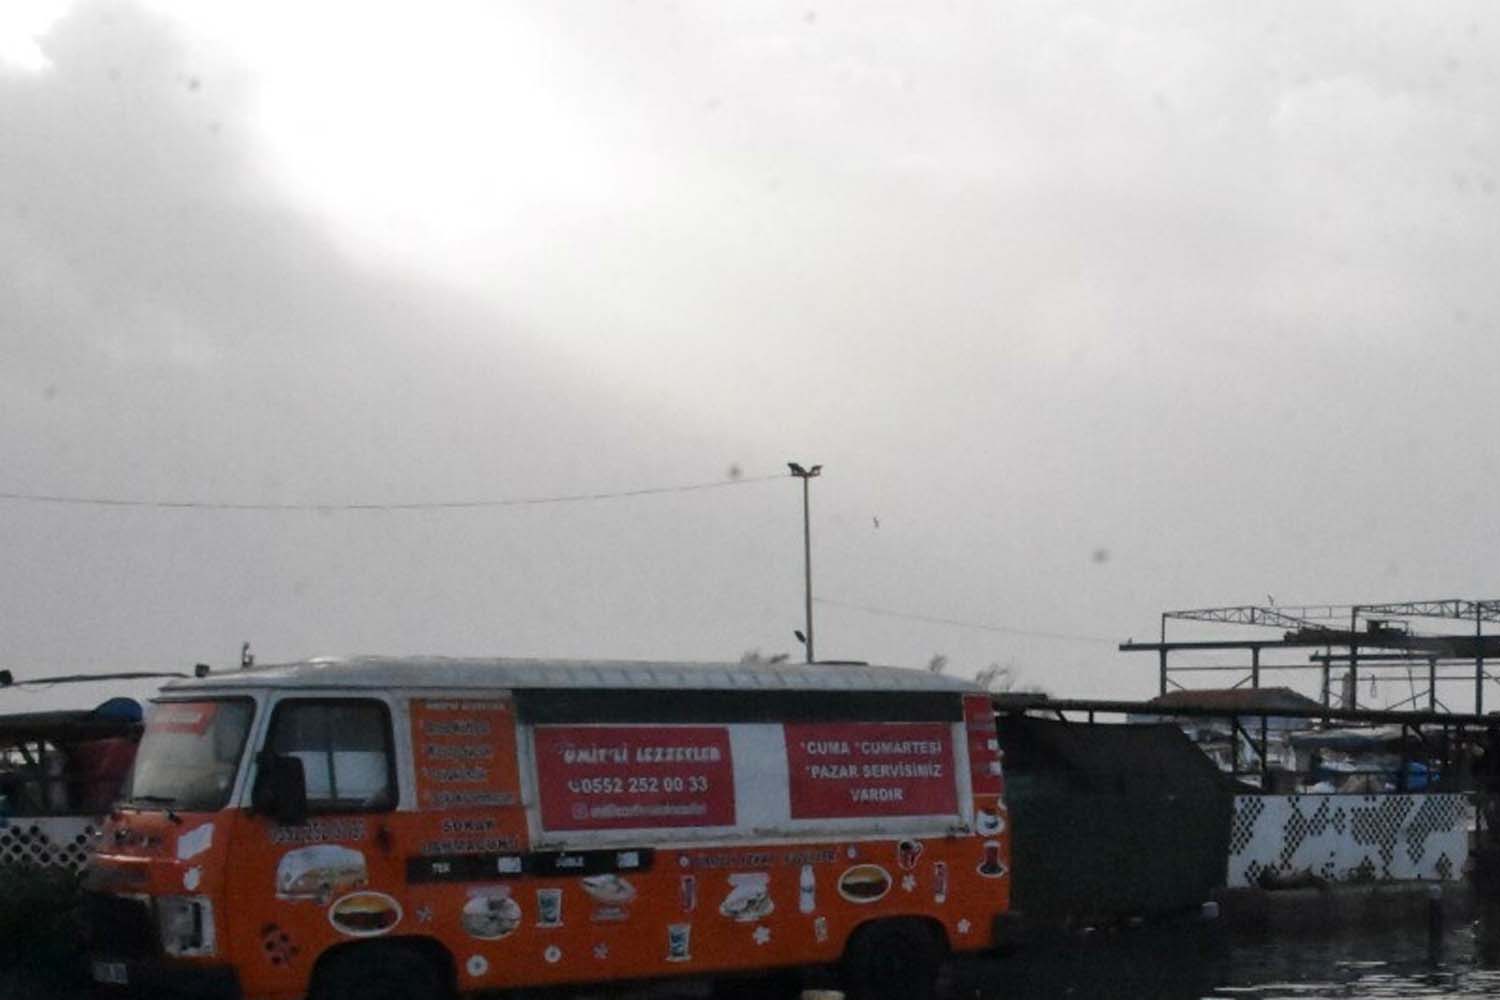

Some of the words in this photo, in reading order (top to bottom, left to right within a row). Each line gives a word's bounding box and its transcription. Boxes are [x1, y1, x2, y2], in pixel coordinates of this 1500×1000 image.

[580, 777, 624, 793] 0552
[627, 776, 659, 793] 252
[687, 775, 709, 792] 33
